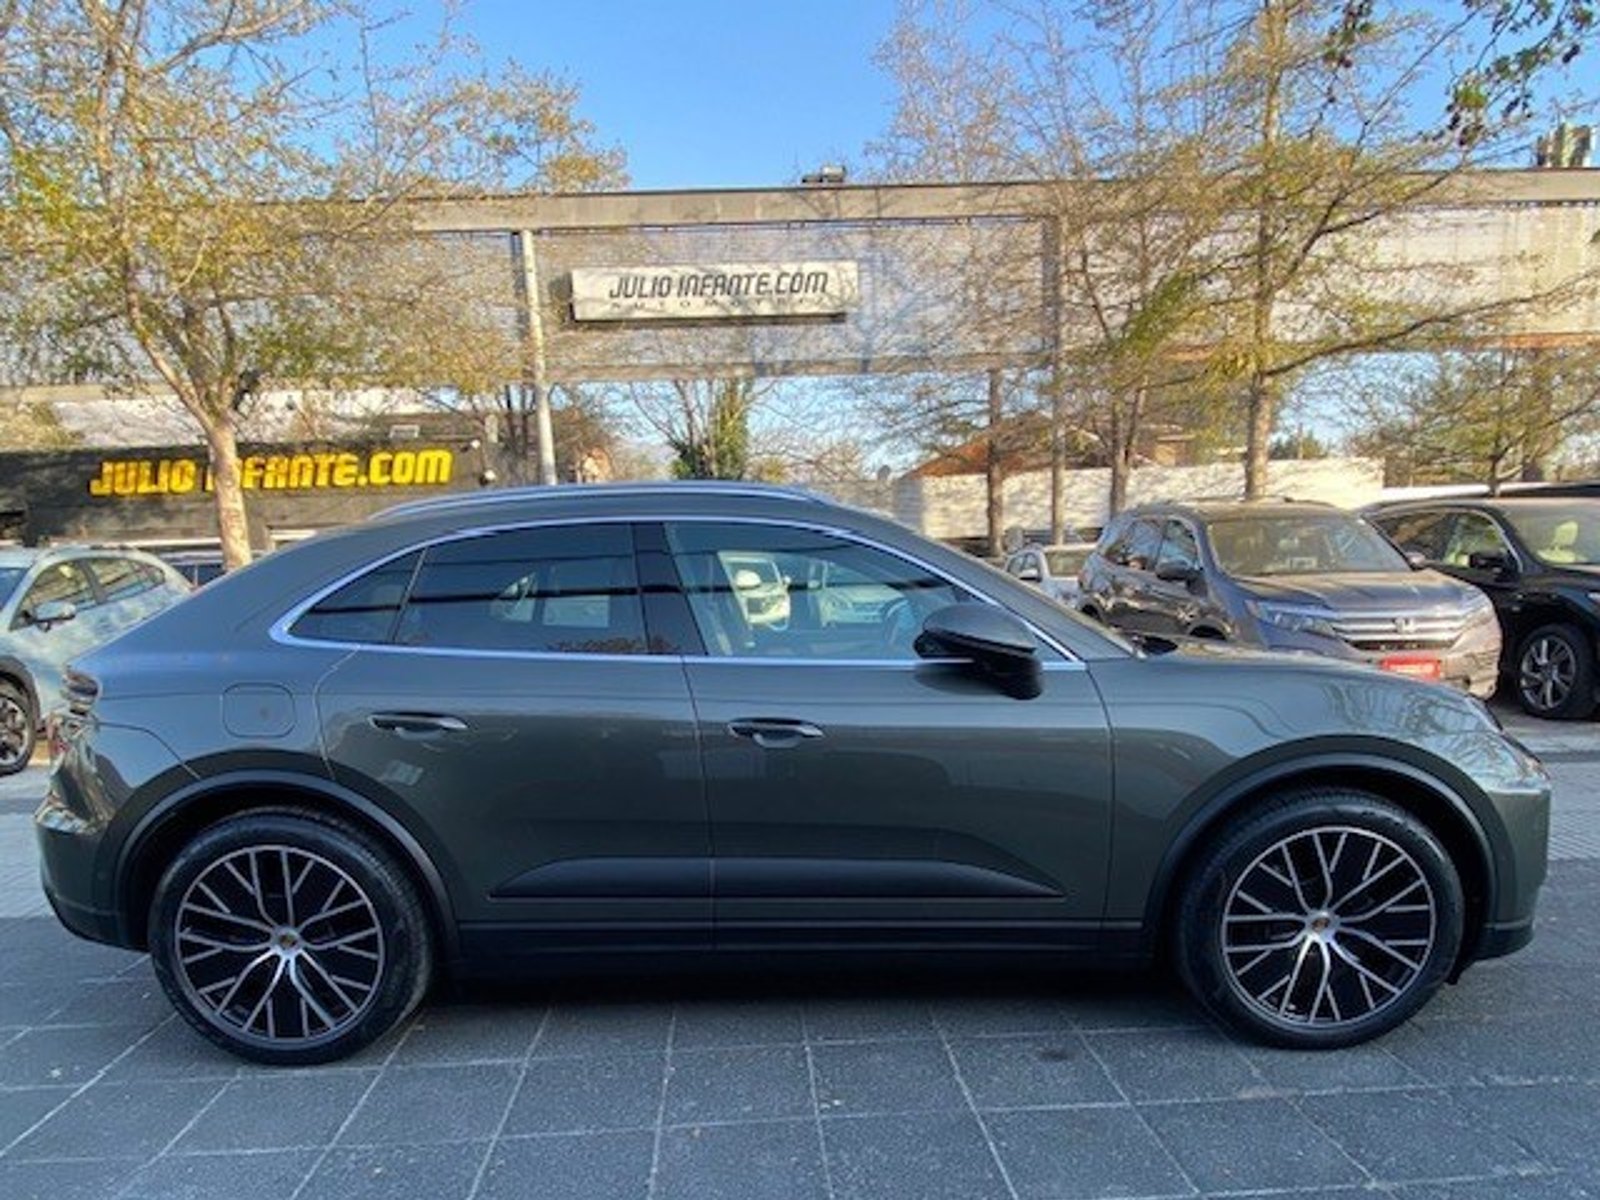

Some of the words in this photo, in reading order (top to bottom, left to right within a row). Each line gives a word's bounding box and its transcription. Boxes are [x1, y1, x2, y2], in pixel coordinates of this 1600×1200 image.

[609, 276, 672, 298] JULIO
[677, 271, 828, 297] INFANTE.COM
[90, 459, 196, 496] JULIO
[205, 449, 453, 491] IFANTE.COM
